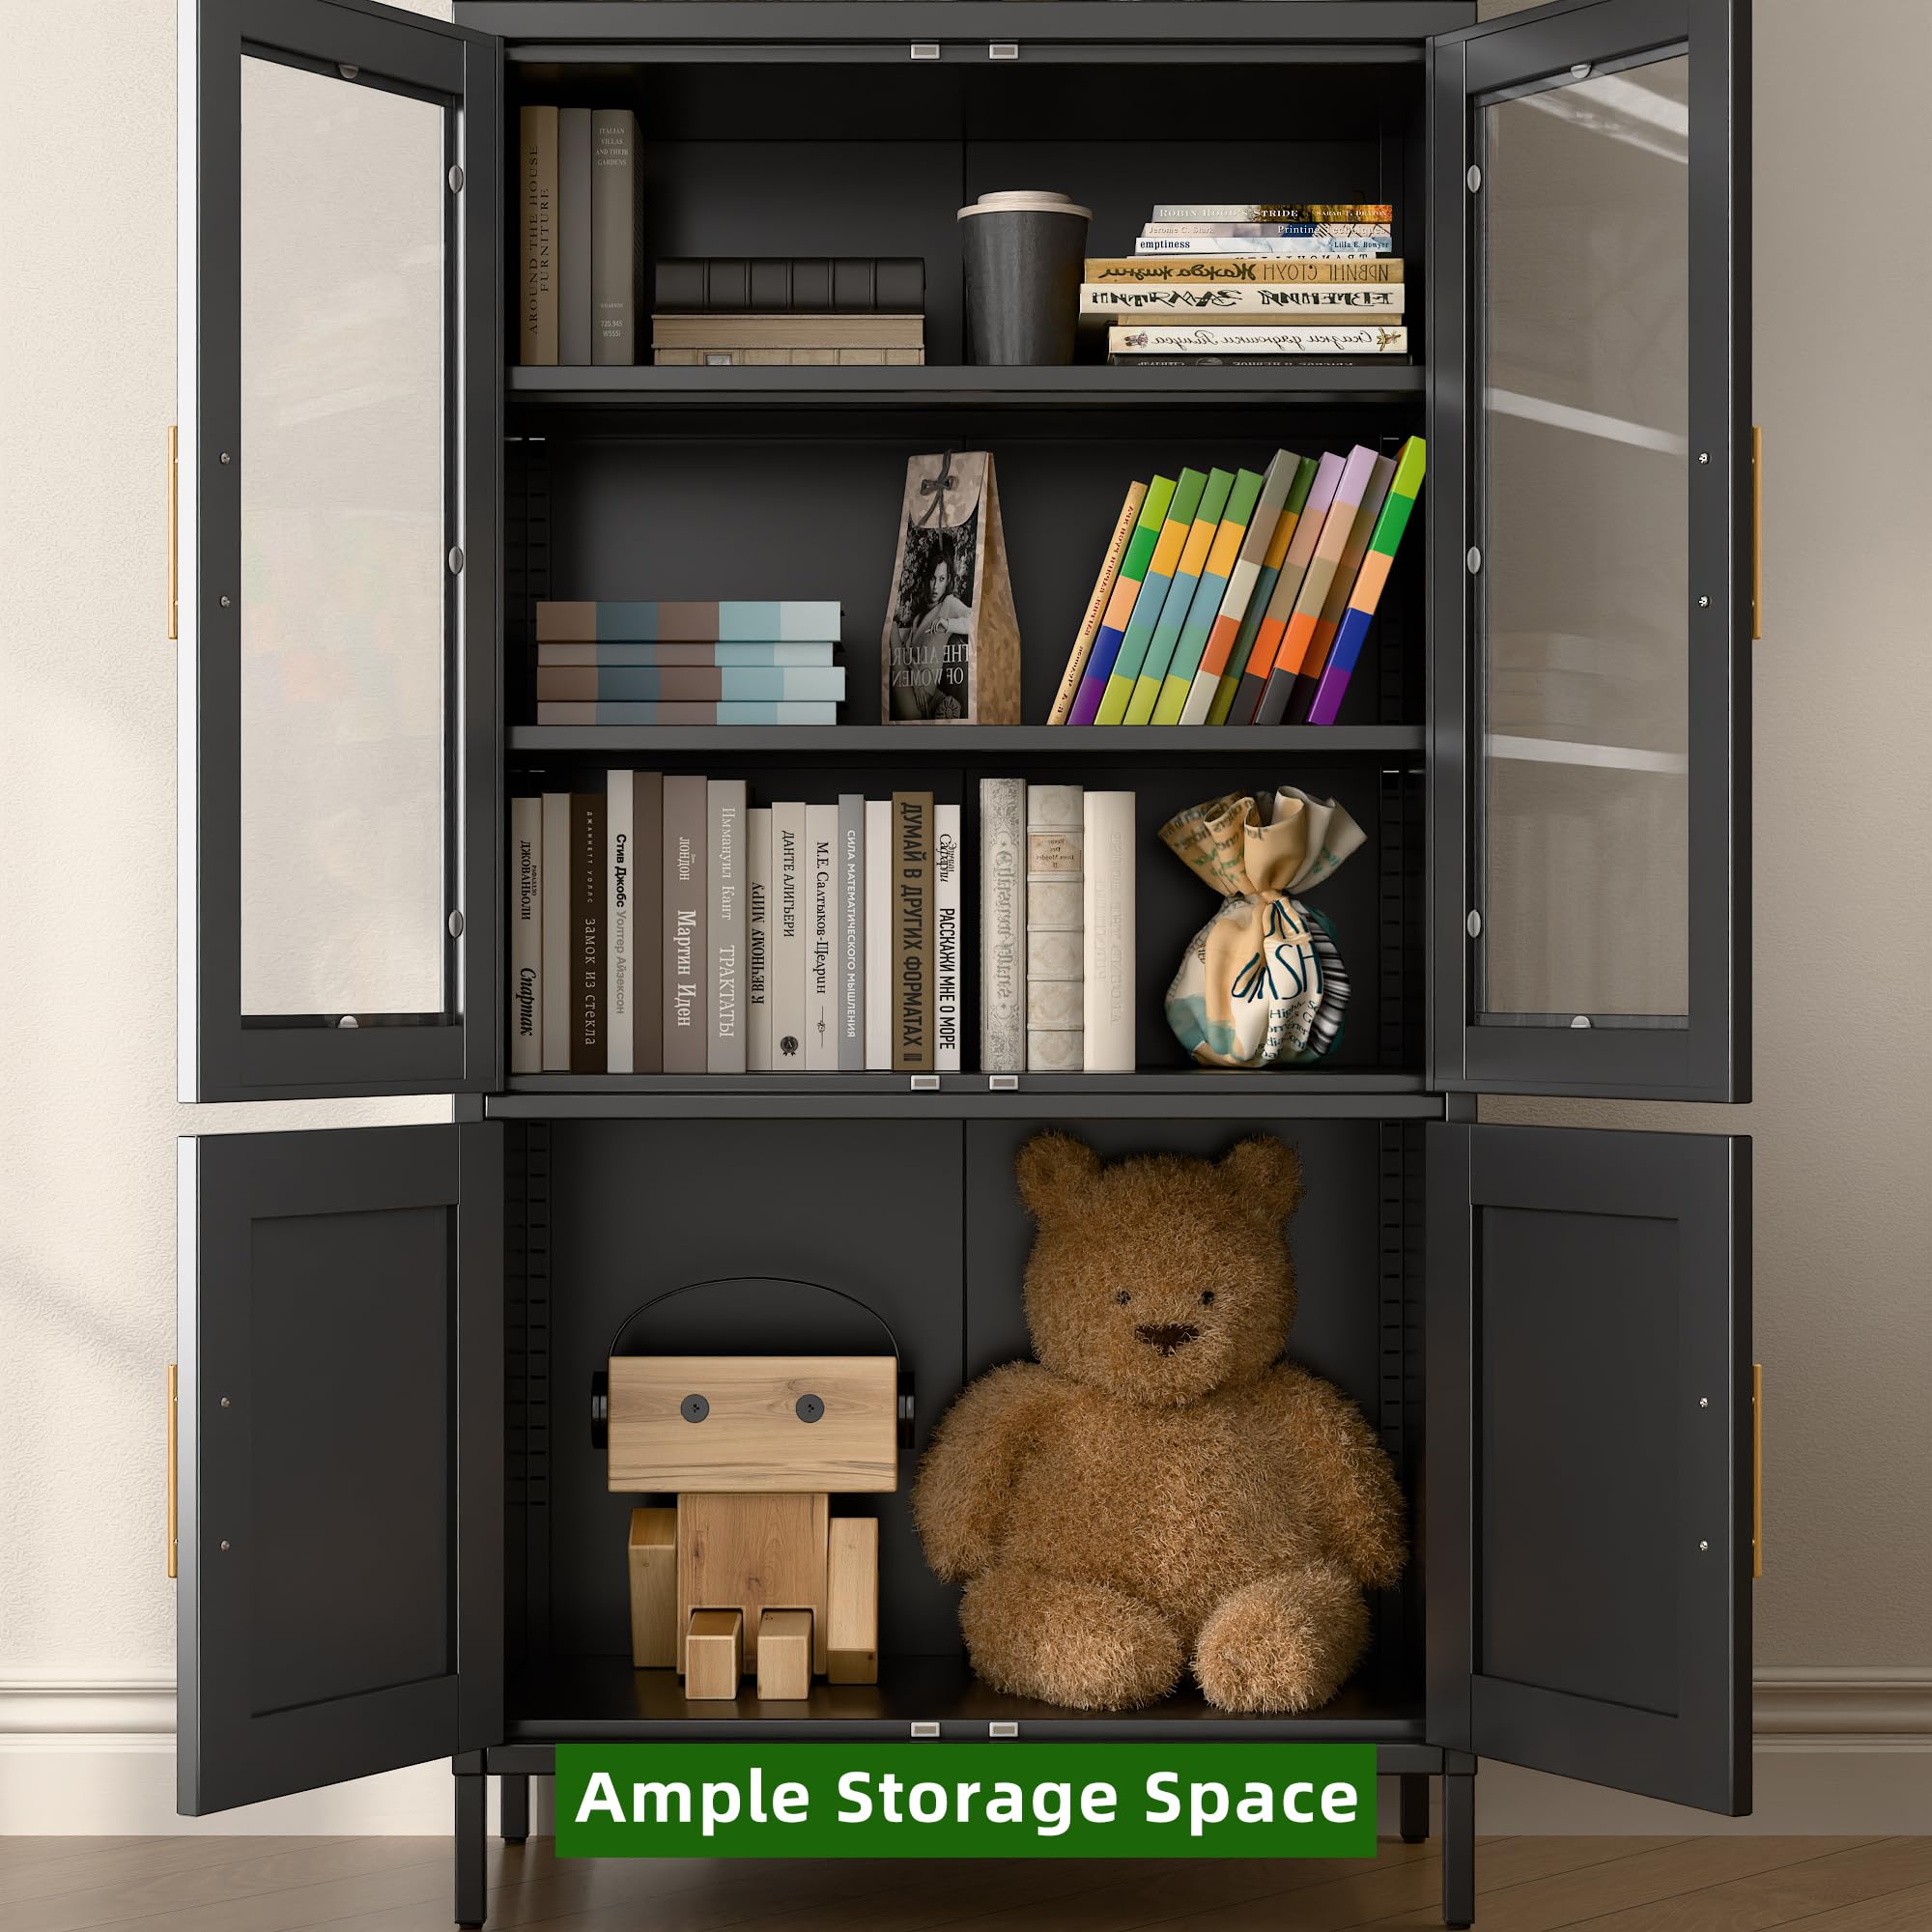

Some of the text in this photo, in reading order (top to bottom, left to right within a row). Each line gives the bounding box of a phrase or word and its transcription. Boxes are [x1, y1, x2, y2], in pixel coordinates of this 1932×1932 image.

[529, 145, 538, 334] AROUND THE HOUSE
[540, 187, 550, 292] FURNITURE
[1140, 240, 1190, 250] emptiness
[1149, 226, 1178, 235] Jerome
[1159, 209, 1198, 218] ROBIN
[1253, 209, 1298, 218] STRIDE
[1278, 225, 1321, 237] Printing
[1334, 241, 1351, 249] Lilla
[1363, 241, 1388, 250] Bowyer
[677, 837, 691, 881] ЛОНДОН
[720, 808, 735, 921] Иммануил Кант
[901, 803, 926, 862] ДУМАЙ
[936, 834, 952, 882] Сафарли
[521, 840, 531, 921] ДЖОВАНЬОЛИ
[614, 834, 627, 908] Стив Джобс
[781, 831, 794, 937] ДАНТЕ АЛИГЬЕРИ
[904, 868, 923, 879] В
[752, 882, 765, 1006] К ВЕЧНОМУ МИРУ
[813, 841, 829, 994] М.Е. Салтыков-Щедрин
[847, 830, 856, 1037] СИЛА МАТЕМАТИЧЕСКОГО МЫШЛЕНИЯ
[901, 885, 923, 951] ДРУГИХ
[940, 908, 955, 972] РАССКАЖИ
[585, 919, 596, 1046] замок из стекла
[614, 910, 627, 1014] Уолтер Айзексон
[673, 910, 696, 1027] Мартин Иден
[720, 945, 735, 1038] ТРАКТАТЫ
[940, 977, 955, 1002] МНЕ
[516, 968, 537, 1037] Спартак
[904, 956, 923, 1046] ФОРМАТАХ
[940, 1017, 955, 1050] МОРЕ
